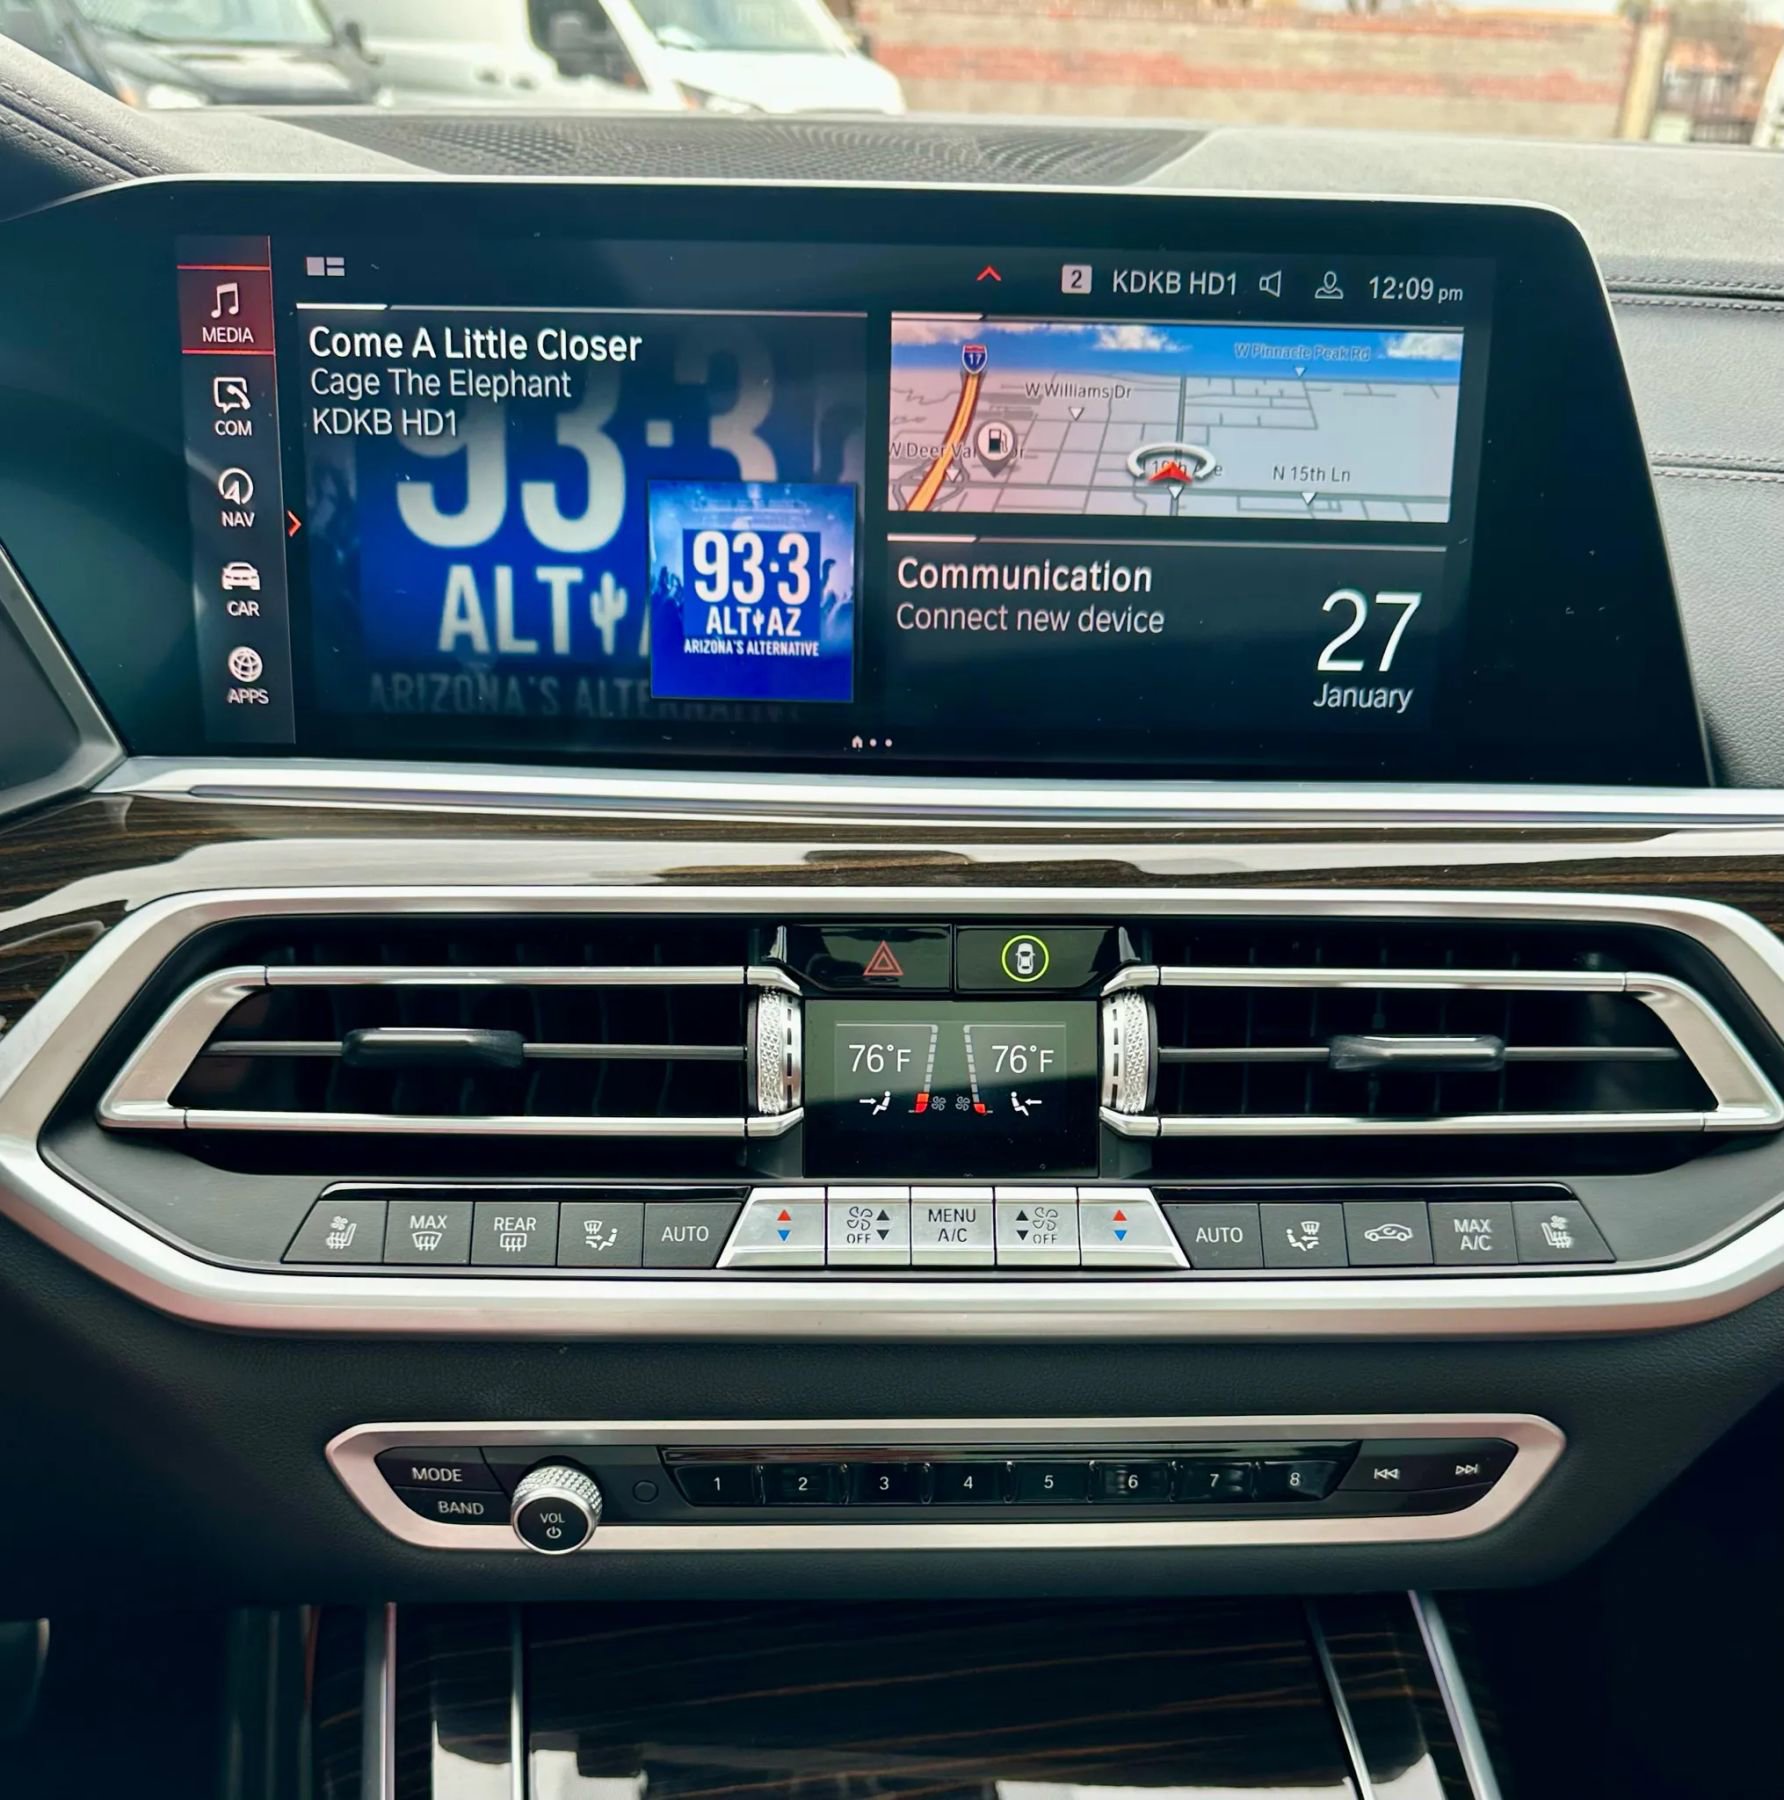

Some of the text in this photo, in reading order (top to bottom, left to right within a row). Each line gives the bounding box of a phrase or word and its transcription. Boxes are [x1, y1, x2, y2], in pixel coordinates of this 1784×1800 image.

[1070, 269, 1082, 289] 2
[1112, 269, 1237, 296] KDKB HD1
[1368, 276, 1464, 303] 12:09 pm
[202, 326, 254, 343] MEDIA
[309, 326, 643, 362] Come A Little Closer
[1252, 343, 1311, 360] Pinnacle
[1314, 345, 1349, 361] Peak
[969, 353, 982, 366] 17
[310, 368, 573, 403] Cage The Elephant
[1025, 383, 1131, 399] W Williams Dr
[214, 421, 253, 437] COM
[312, 407, 457, 437] KDKB HD1
[1273, 466, 1350, 482] N 15th Ln
[221, 511, 255, 528] NAV
[897, 557, 1152, 592] Communication
[227, 601, 261, 618] CAR
[437, 563, 584, 656] ALT
[706, 605, 802, 637] ALT AZ
[896, 602, 1165, 634] Connect new device
[1317, 589, 1423, 673] 27
[684, 639, 820, 657] ARIZONA'S ALTERNATIVE
[227, 689, 270, 705] APPS
[1312, 682, 1414, 714] January
[410, 1215, 448, 1230] MAX
[928, 1208, 976, 1224] MENU
[494, 1218, 536, 1231] REAR
[1454, 1218, 1491, 1234] MAX
[661, 1226, 709, 1242] AUTO
[846, 1233, 871, 1244] OFF
[938, 1228, 968, 1243] A/C
[1032, 1233, 1058, 1244] OFF
[1196, 1227, 1243, 1243] AUTO
[1460, 1235, 1492, 1251] A/C
[411, 1467, 463, 1483] MODE
[963, 1476, 974, 1489] 4
[1043, 1475, 1054, 1489] 5
[1127, 1475, 1138, 1489] 6
[1209, 1474, 1220, 1488] 7
[1289, 1472, 1301, 1486] 8
[713, 1477, 721, 1490] 1
[798, 1477, 808, 1491] 2
[879, 1477, 889, 1490] 3
[438, 1501, 484, 1516] BAND
[540, 1513, 566, 1524] VOL
